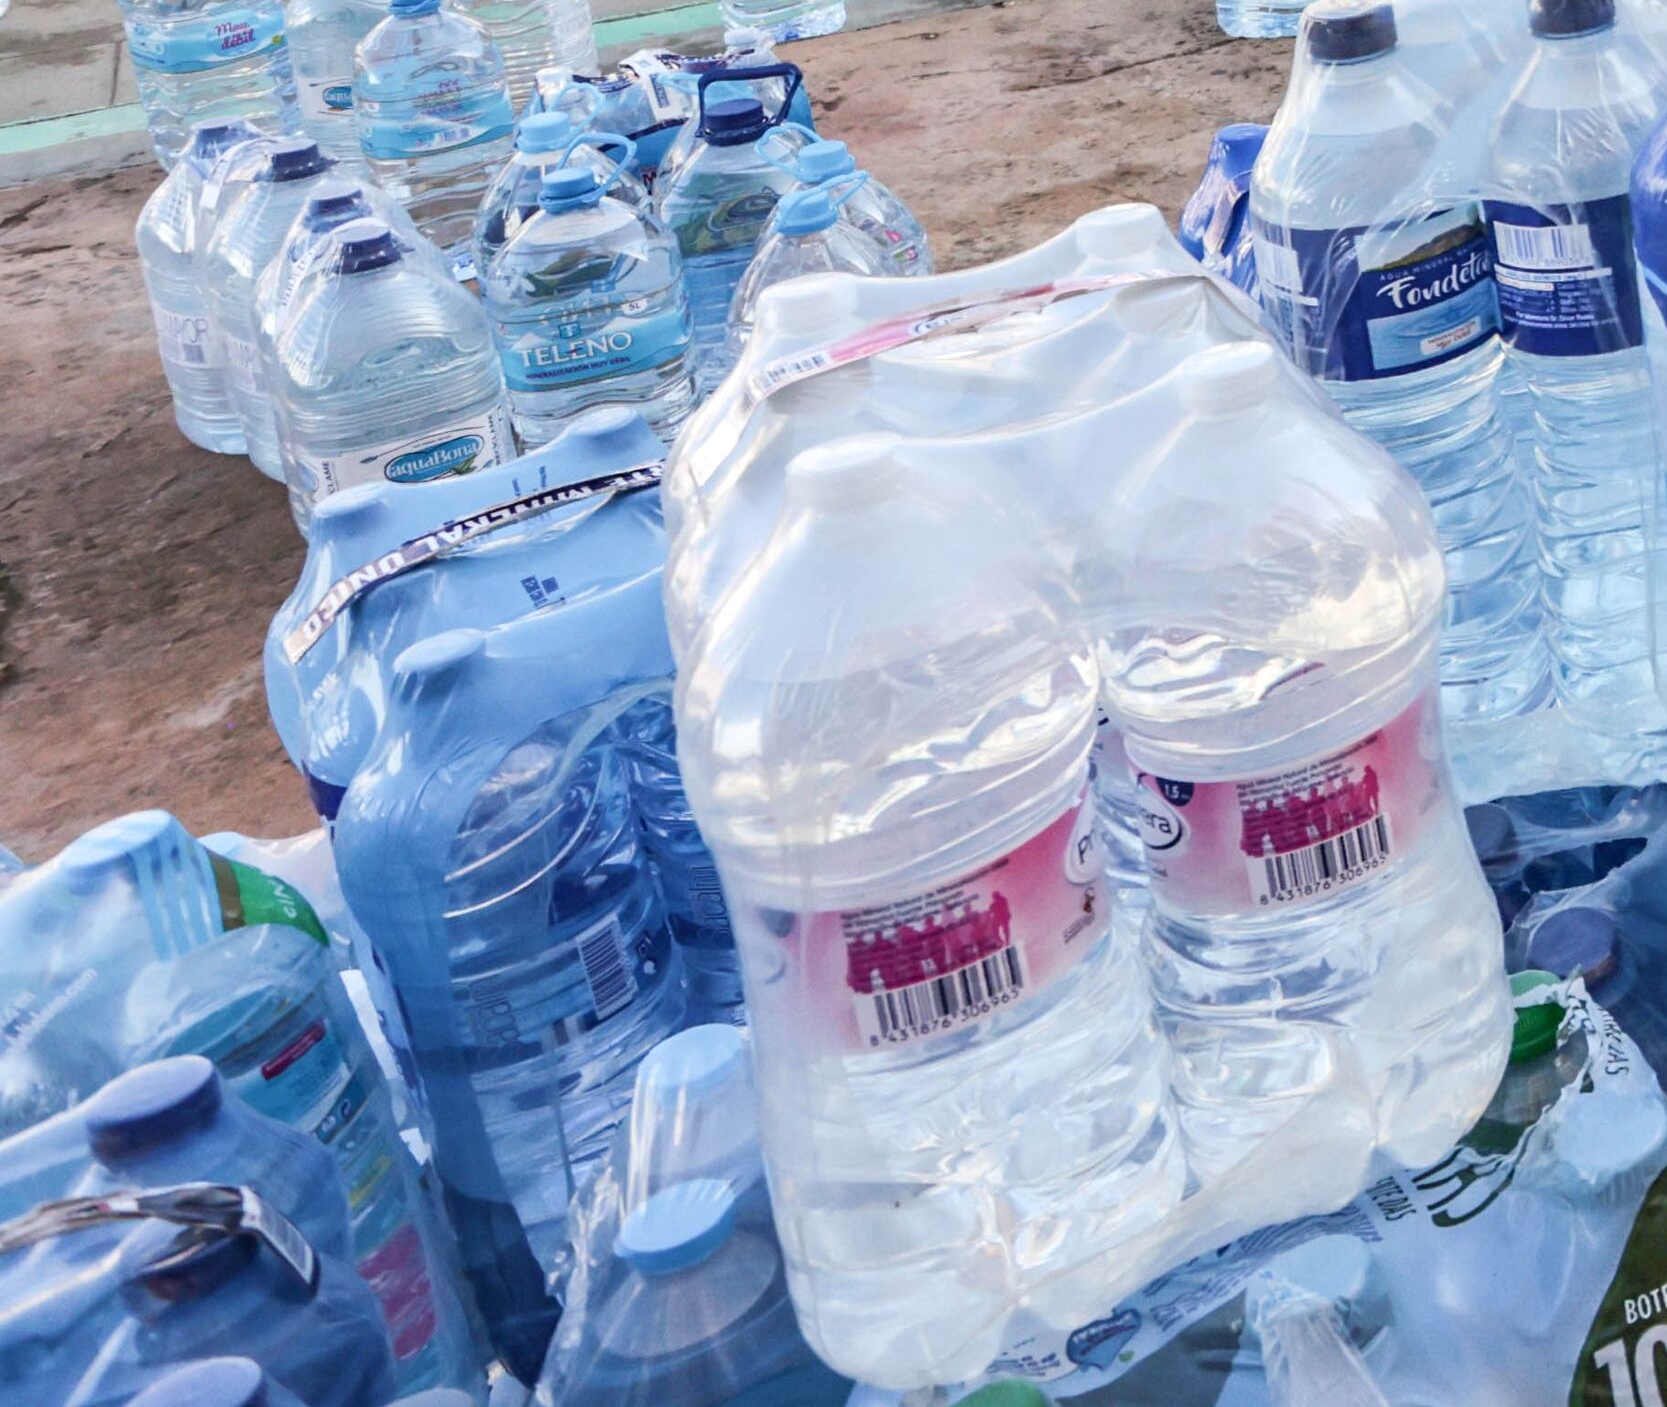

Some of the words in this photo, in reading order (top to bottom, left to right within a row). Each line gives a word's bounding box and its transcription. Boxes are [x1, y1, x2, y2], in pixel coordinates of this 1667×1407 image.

[518, 331, 633, 368] TELENO
[388, 440, 481, 480] aquaBona
[886, 1015, 954, 1044] 431876
